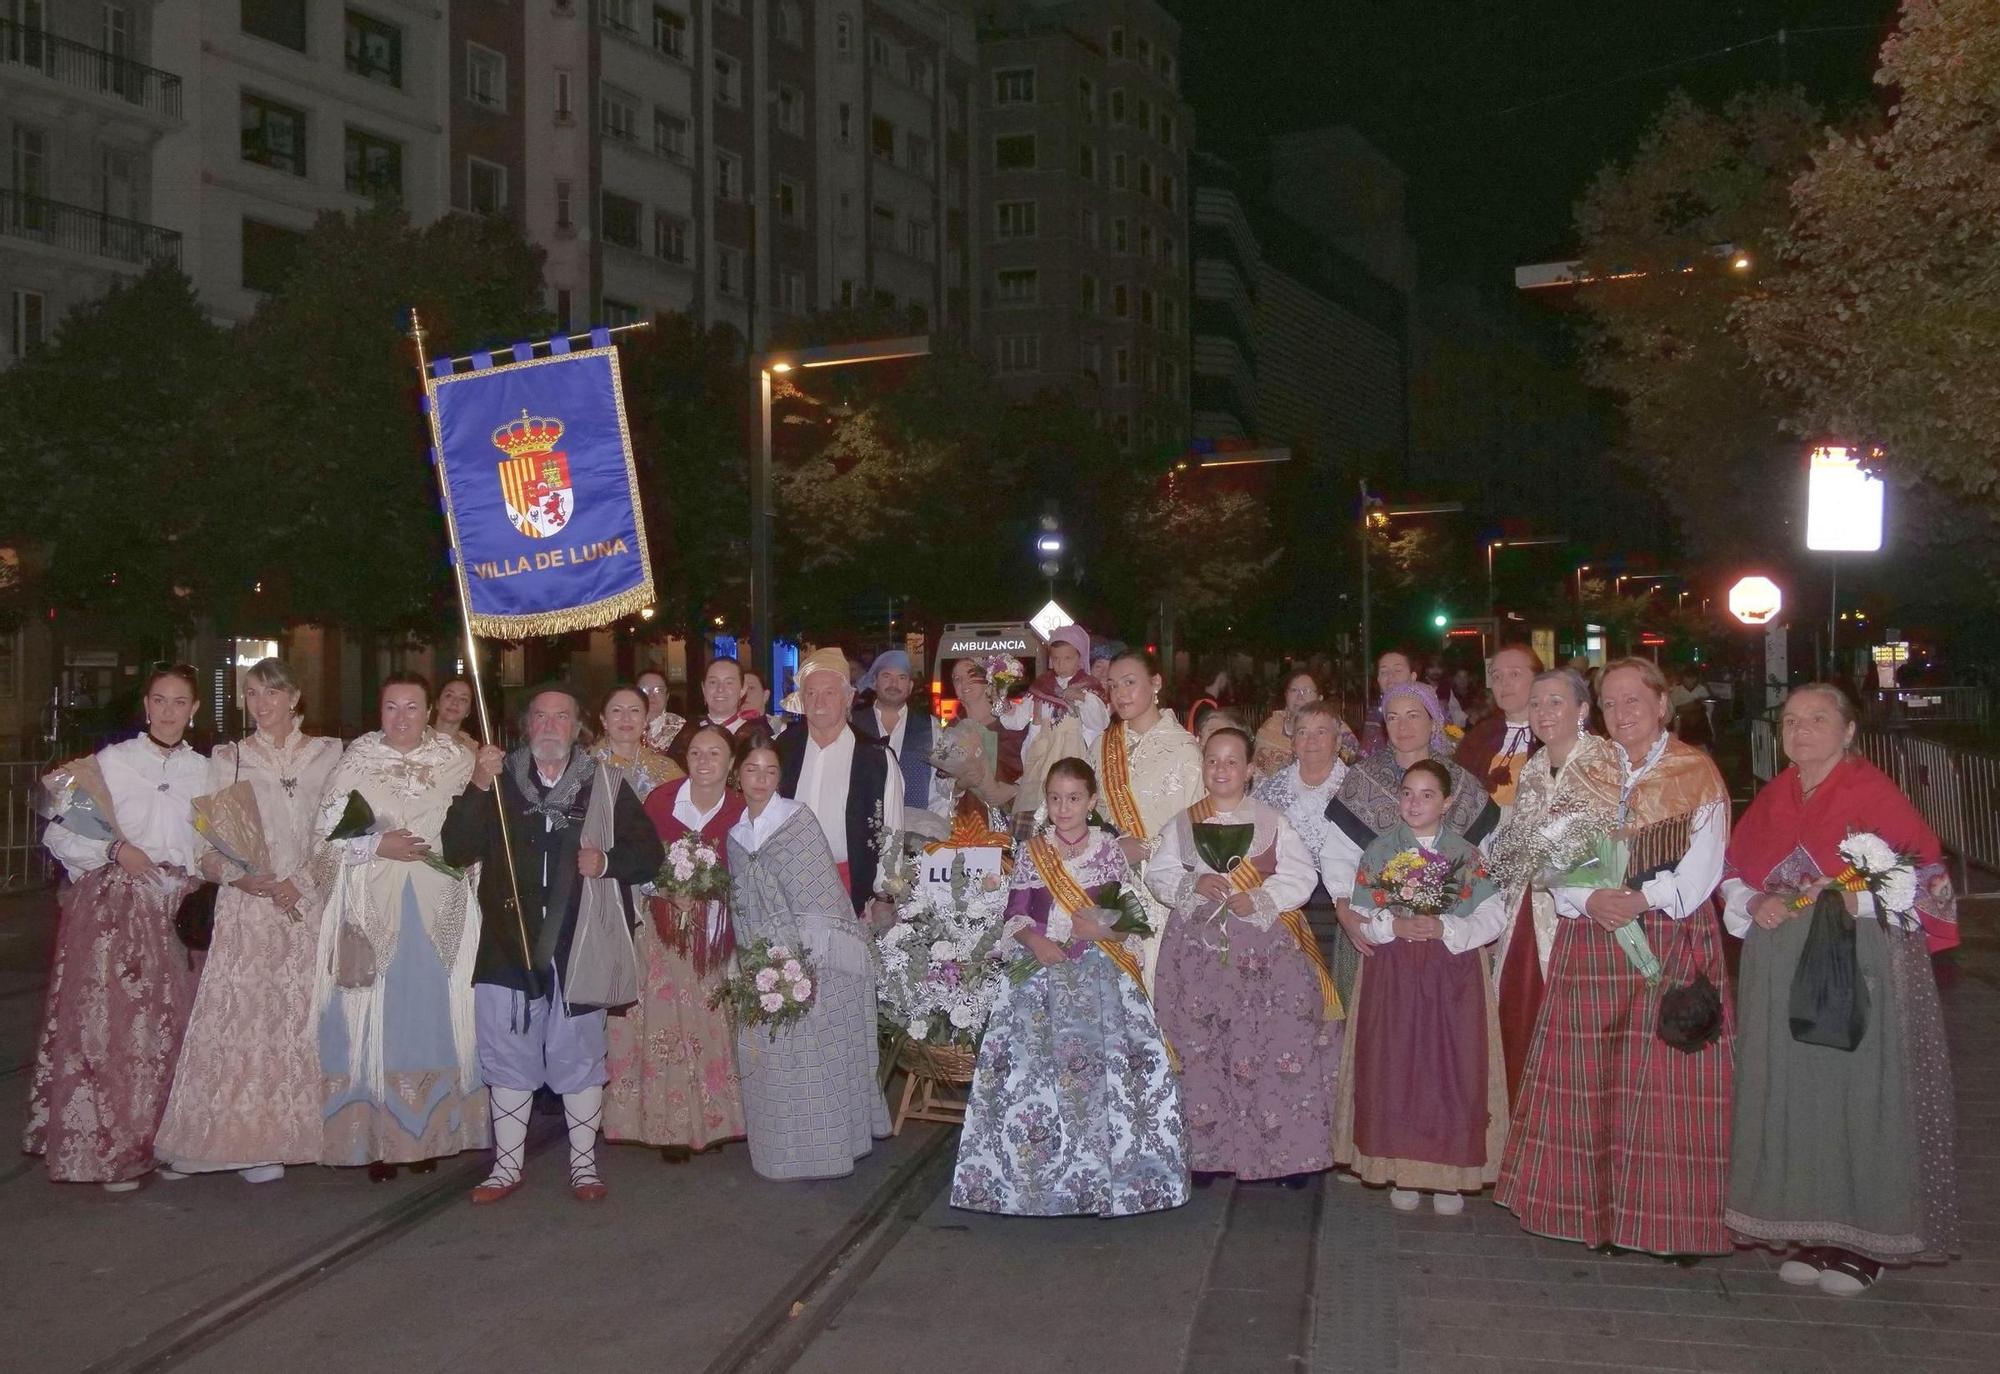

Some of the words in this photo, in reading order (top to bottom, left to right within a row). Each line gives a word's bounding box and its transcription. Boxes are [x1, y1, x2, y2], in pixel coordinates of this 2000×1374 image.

[474, 556, 532, 580] VILLA
[535, 549, 565, 570] DE
[569, 538, 629, 564] LUNA
[1042, 615, 1062, 630] 30
[951, 640, 1026, 651] AMBULANCIA
[929, 867, 985, 883] LU
